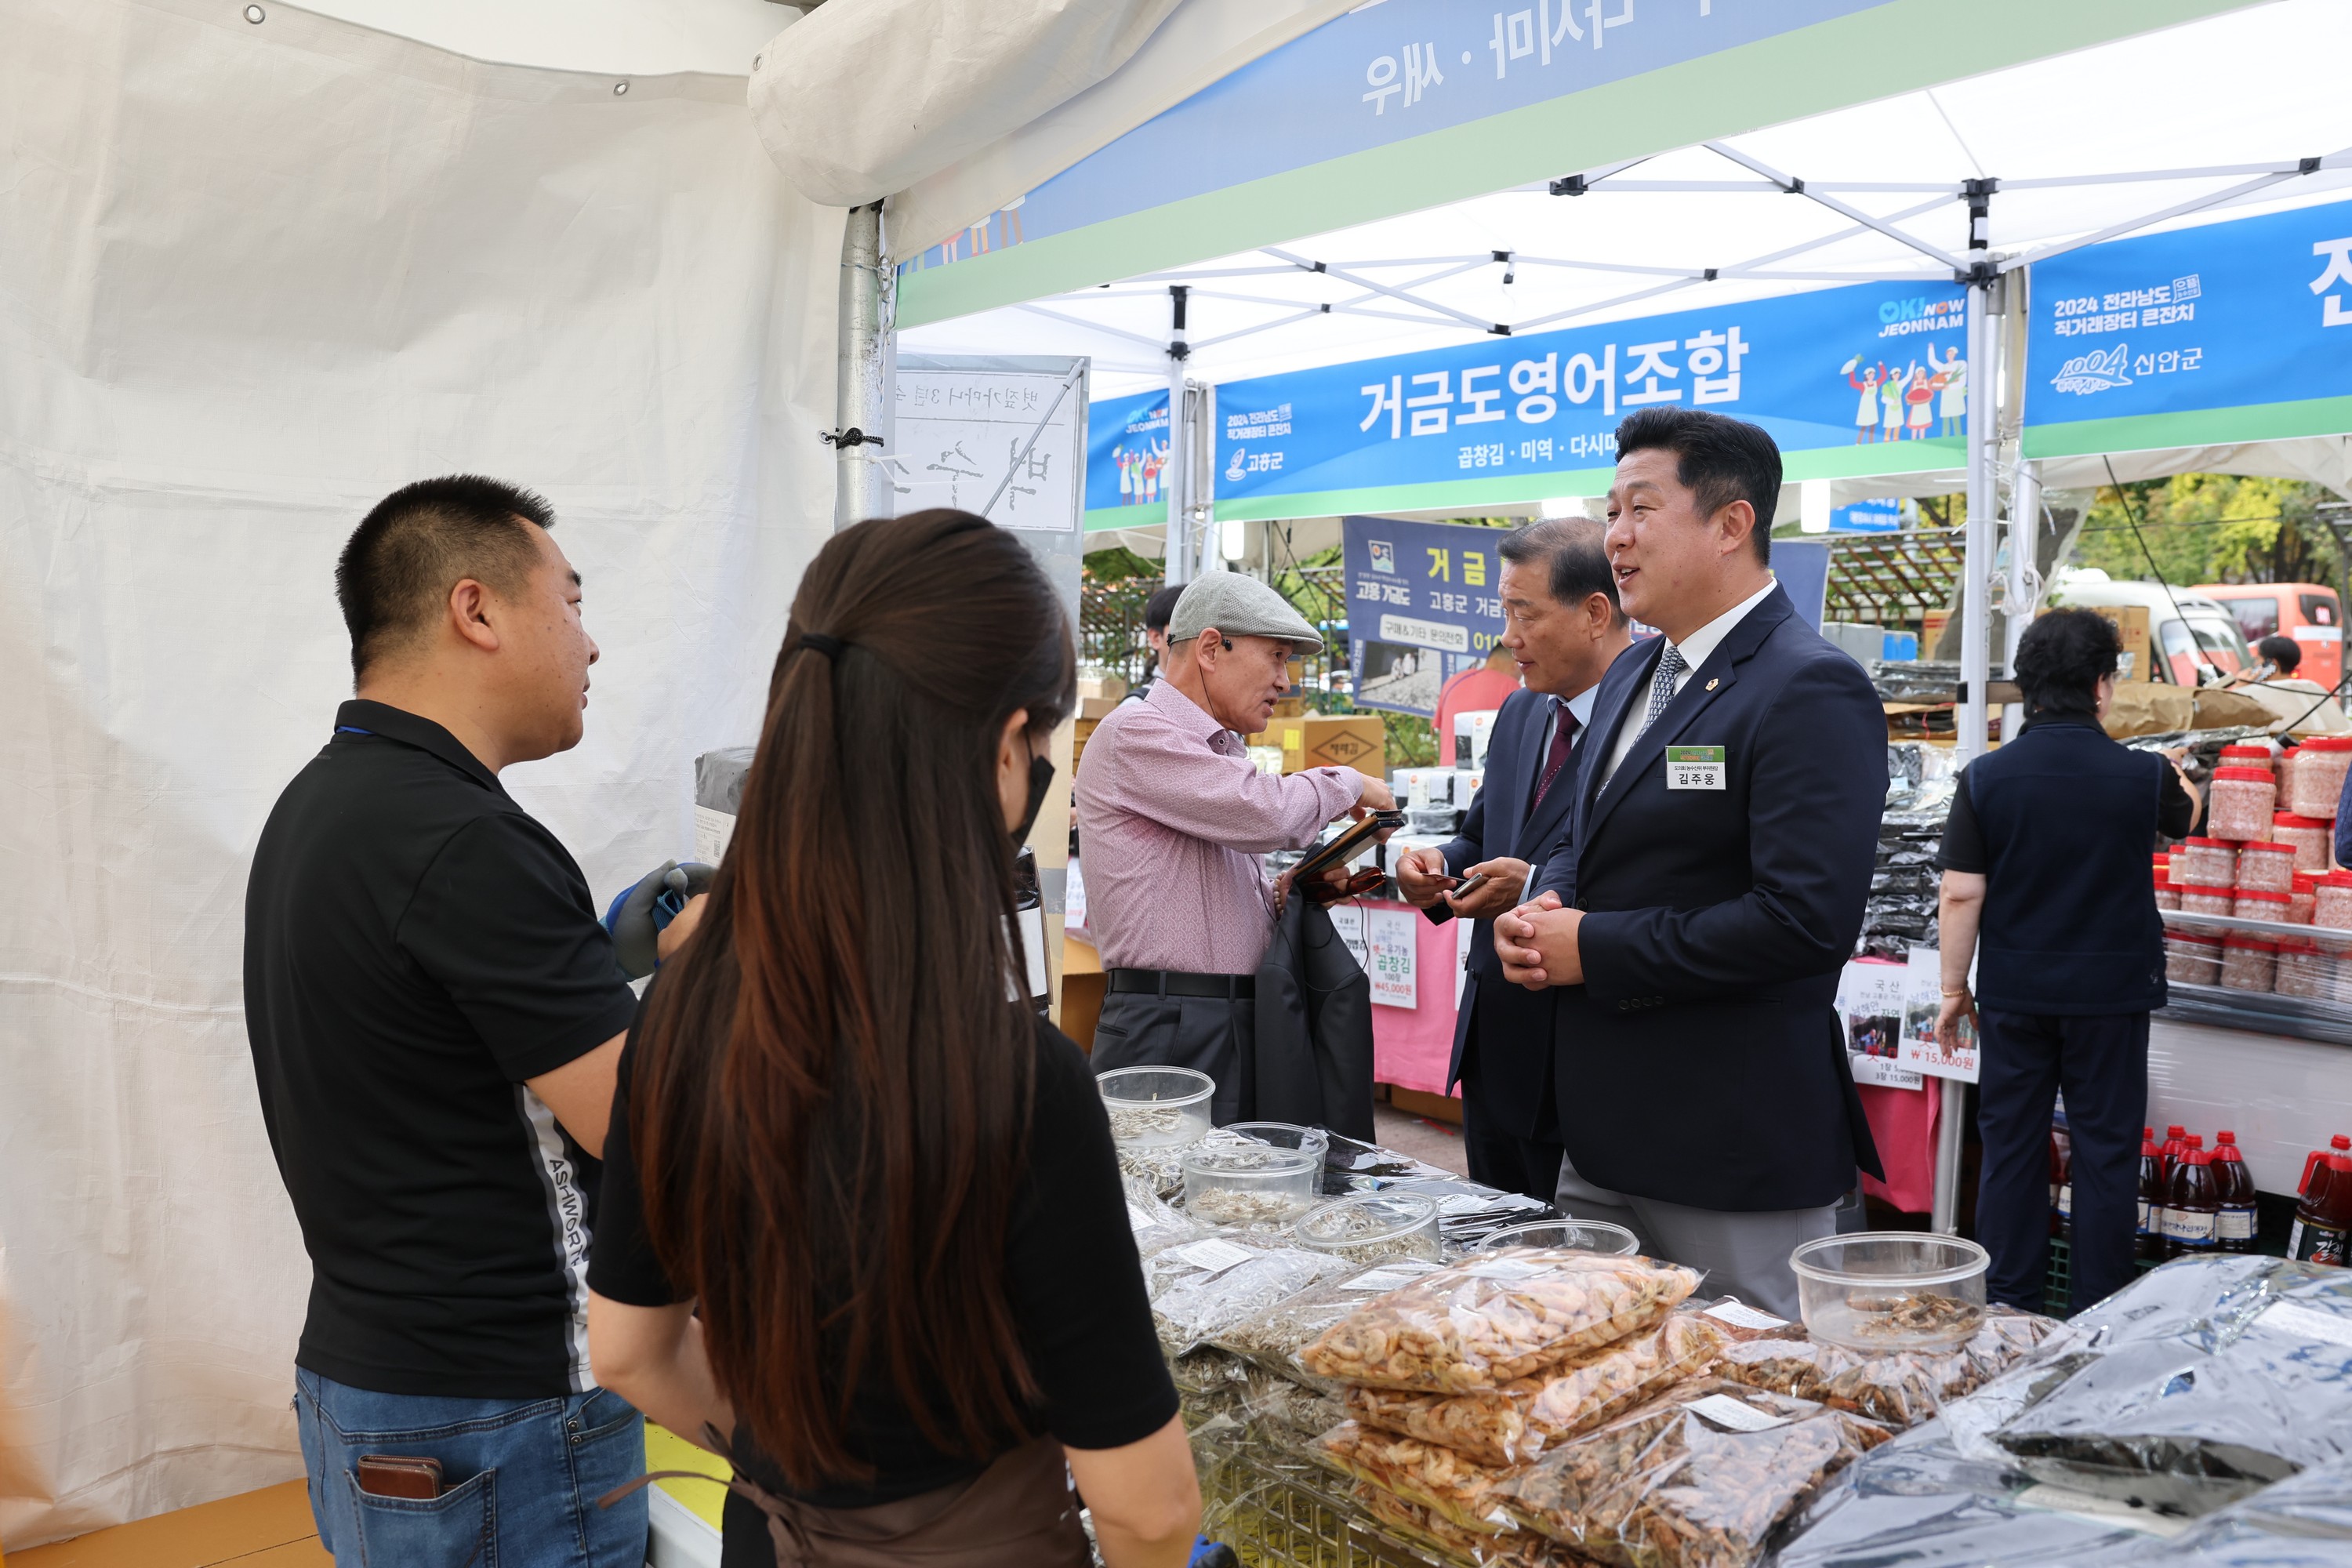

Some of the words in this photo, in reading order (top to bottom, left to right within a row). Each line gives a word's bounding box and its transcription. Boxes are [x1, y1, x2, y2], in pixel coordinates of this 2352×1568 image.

[1878, 297, 1926, 324] OK!
[1924, 299, 1965, 317] NOW
[2054, 296, 2099, 318] 2024
[2103, 285, 2171, 311] 전라남도
[1878, 314, 1965, 338] JEONNAM
[2054, 310, 2137, 336] 직거래장터
[2141, 303, 2194, 327] 큰잔치
[2133, 347, 2203, 376] 신안군
[1359, 325, 1749, 440] 거금도영어조합
[1227, 416, 1249, 427] 2024
[1249, 409, 1279, 425] 전라남도
[1247, 451, 1284, 471] 고흥군
[1457, 441, 1505, 469] 곱창김
[1520, 437, 1554, 464] 미역
[1429, 591, 1468, 614] 고흥군
[1475, 597, 1506, 619] 거금
[1679, 773, 1715, 786] 김주웅
[1377, 955, 1410, 974] 곱창김
[1926, 1051, 1974, 1071] 15,000원
[1890, 1074, 1921, 1085] 15,000원
